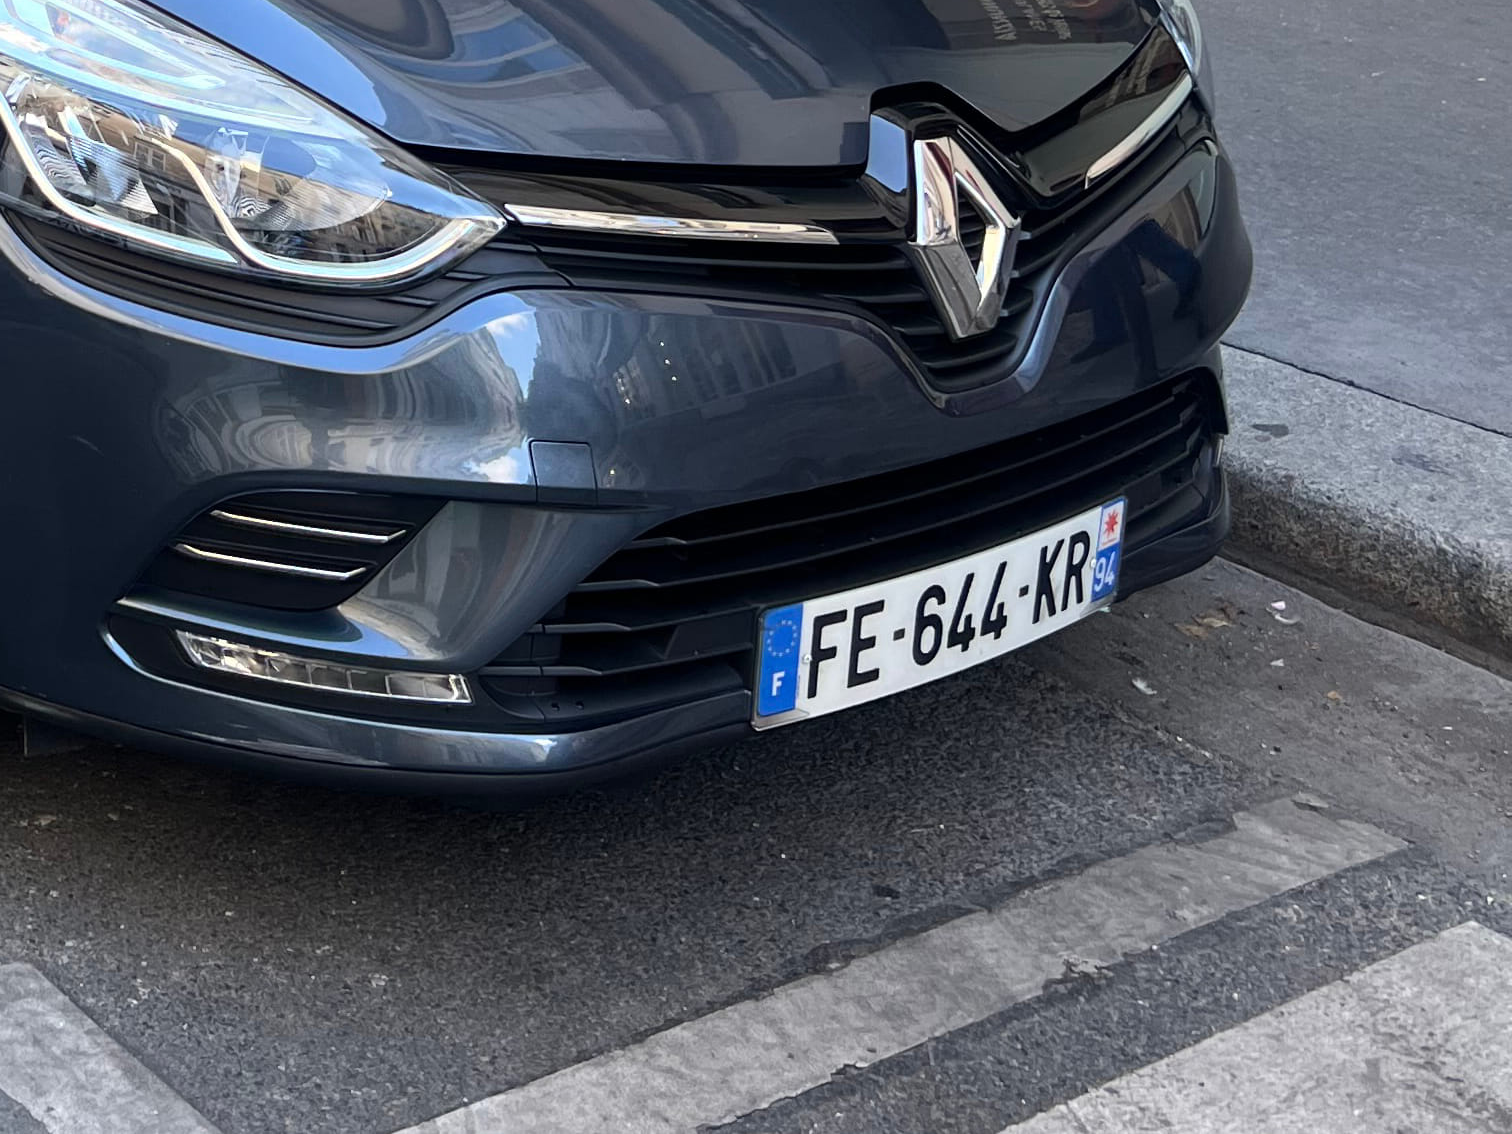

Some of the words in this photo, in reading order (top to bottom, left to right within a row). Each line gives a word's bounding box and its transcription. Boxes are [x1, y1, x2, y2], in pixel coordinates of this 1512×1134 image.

[1093, 551, 1116, 592] 94
[807, 530, 1091, 699] FE-644-KR
[771, 671, 785, 697] F
